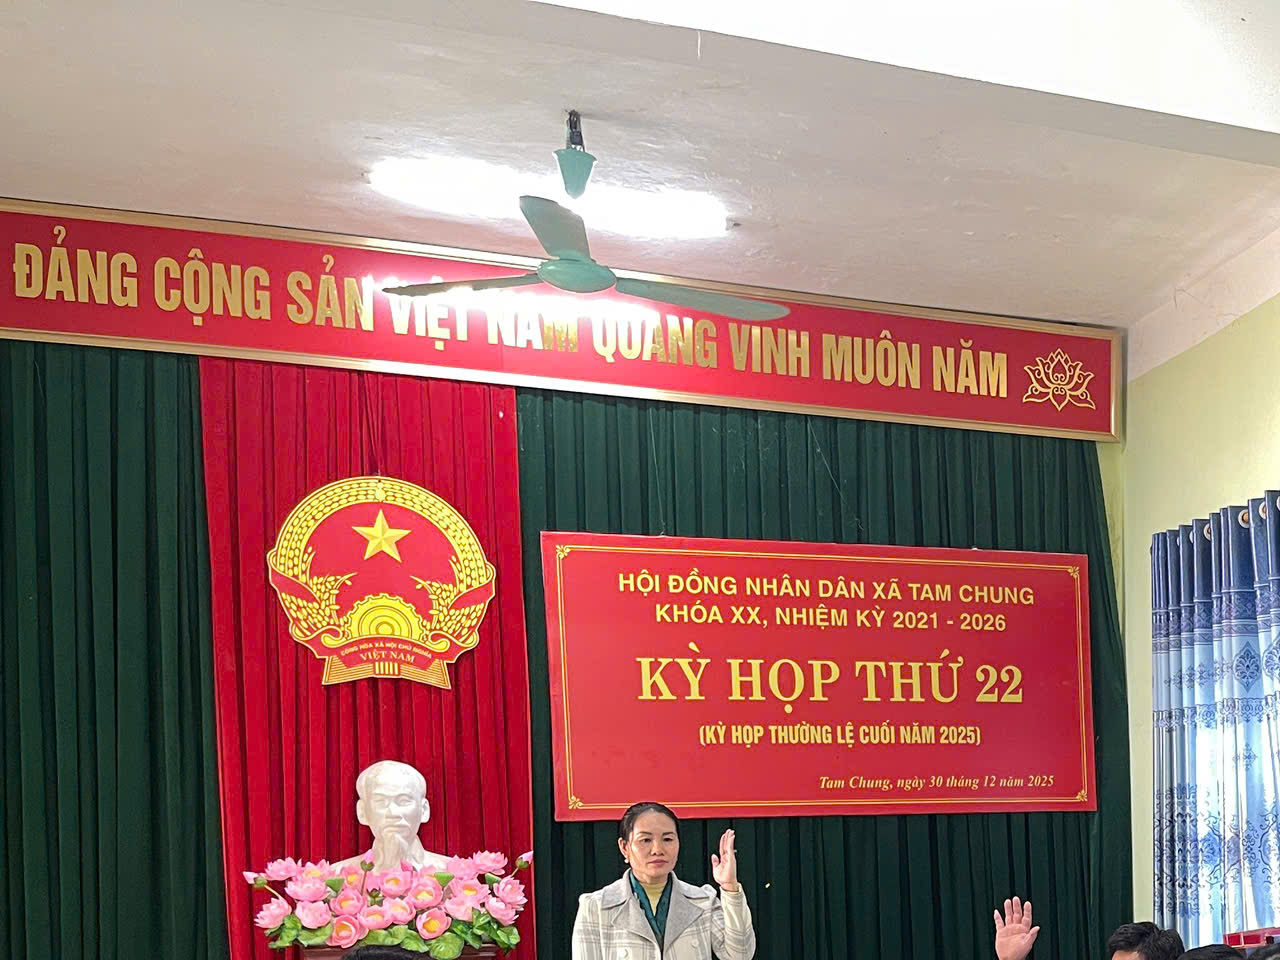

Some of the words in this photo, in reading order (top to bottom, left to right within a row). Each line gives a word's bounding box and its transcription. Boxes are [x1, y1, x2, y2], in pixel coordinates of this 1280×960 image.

[13, 225, 138, 308] ĐẢNG
[154, 248, 271, 326] CỘNG
[287, 255, 375, 331] SẢN
[485, 297, 578, 353] NAM
[591, 306, 717, 369] QUANG
[729, 325, 810, 378] VINH
[822, 329, 921, 390] MUÔN
[932, 338, 1007, 398] NĂM
[618, 568, 661, 596] HỘI
[667, 567, 738, 596] ĐỒNG
[745, 573, 811, 597] NHÂN
[818, 575, 865, 599] DÂN
[872, 578, 902, 600] XÃ
[907, 583, 952, 602] TAM
[959, 584, 1034, 605] CHUNG
[655, 601, 724, 624] KHÓA
[730, 605, 768, 629] XX,
[775, 603, 848, 630] NHIỆM
[856, 605, 886, 628] KỲ
[892, 610, 938, 629] 2021
[959, 612, 1006, 631] 2026
[390, 651, 415, 663] NAM
[635, 641, 712, 700] KỲ
[726, 658, 840, 714] HỌP
[855, 648, 964, 703] THỨ
[975, 664, 1023, 703] 22
[699, 721, 727, 747] (KỲ
[731, 724, 764, 749] HỌP
[768, 723, 833, 745] THƯỜNG
[836, 723, 855, 748] LỆ
[859, 719, 896, 745] CUỐI
[899, 723, 936, 744] NĂM
[939, 725, 981, 746] 2025)
[819, 776, 845, 789] Tam
[849, 776, 893, 791] Chung,
[897, 775, 926, 791] ngày
[929, 775, 943, 788] 30
[946, 775, 980, 790] tháng
[984, 775, 997, 787] 12
[999, 776, 1024, 787] năm
[1027, 775, 1054, 787] 2025
